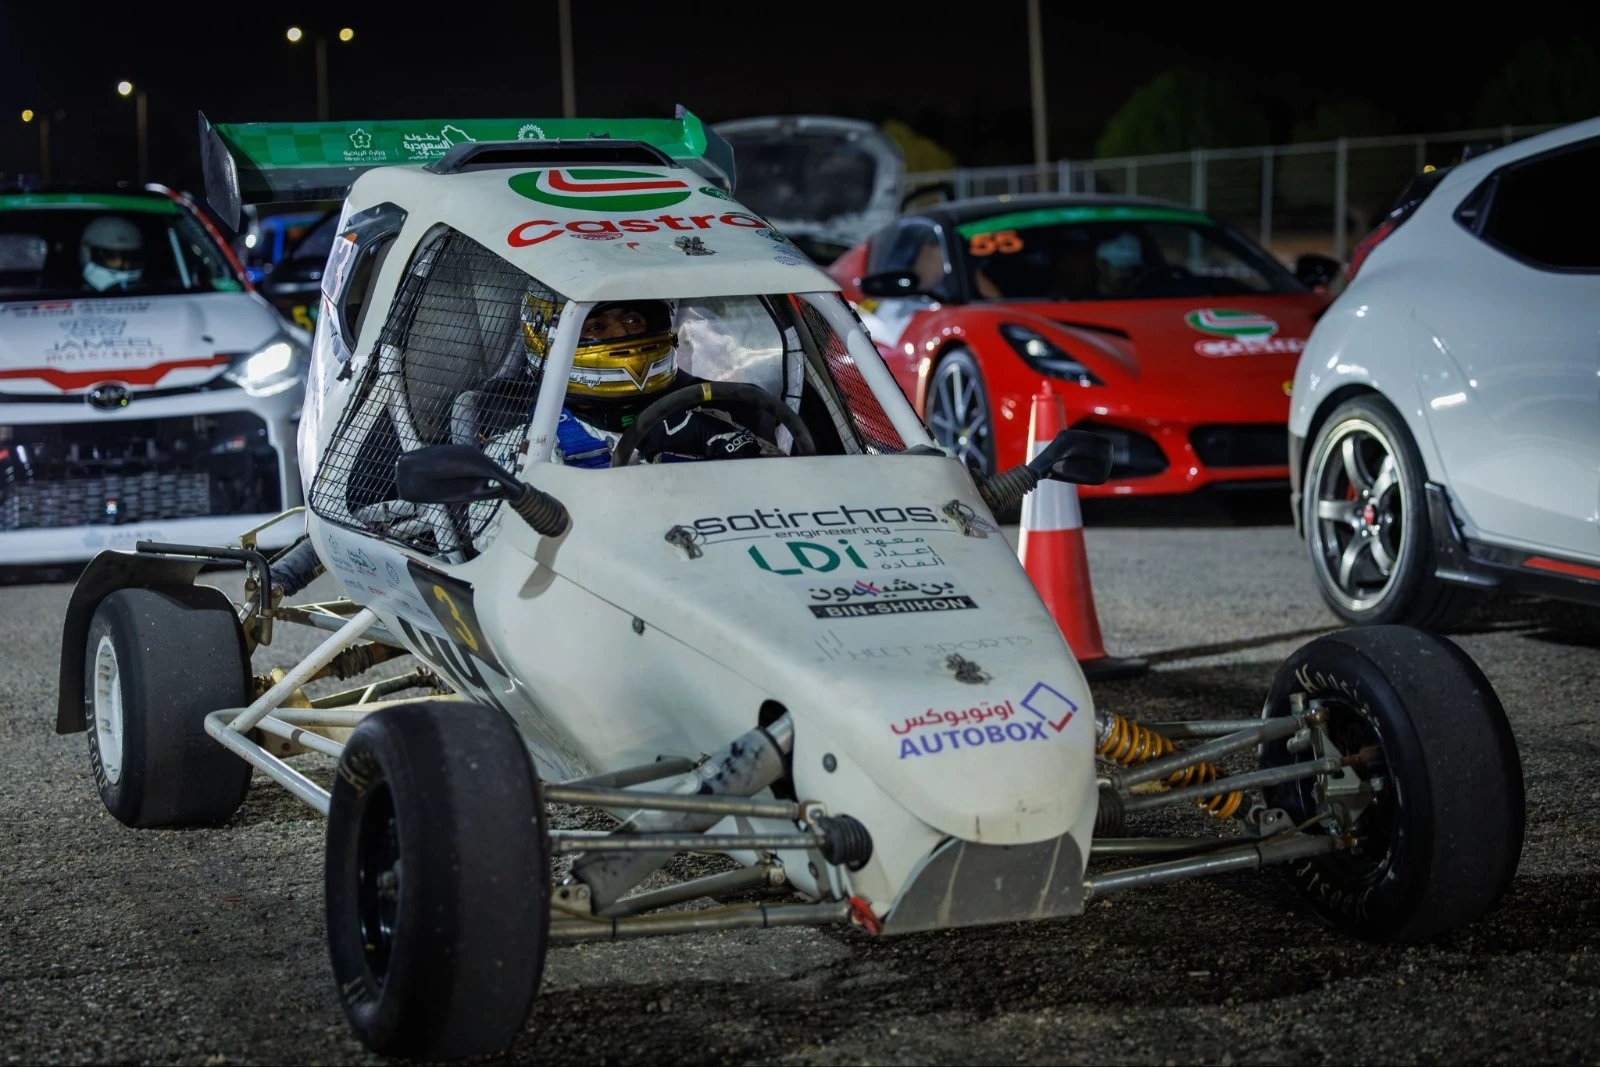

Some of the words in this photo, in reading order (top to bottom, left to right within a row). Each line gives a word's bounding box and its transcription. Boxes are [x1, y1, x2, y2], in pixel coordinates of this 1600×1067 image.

[507, 214, 767, 248] Castro
[969, 230, 1024, 256] 55
[775, 526, 890, 539] engineering
[864, 537, 925, 548] معهد
[880, 557, 946, 570] القادة
[921, 581, 955, 596] بن
[433, 584, 479, 651] 3
[827, 597, 967, 618] BIN-SHIHON
[898, 721, 1049, 760] AUTOBOX
